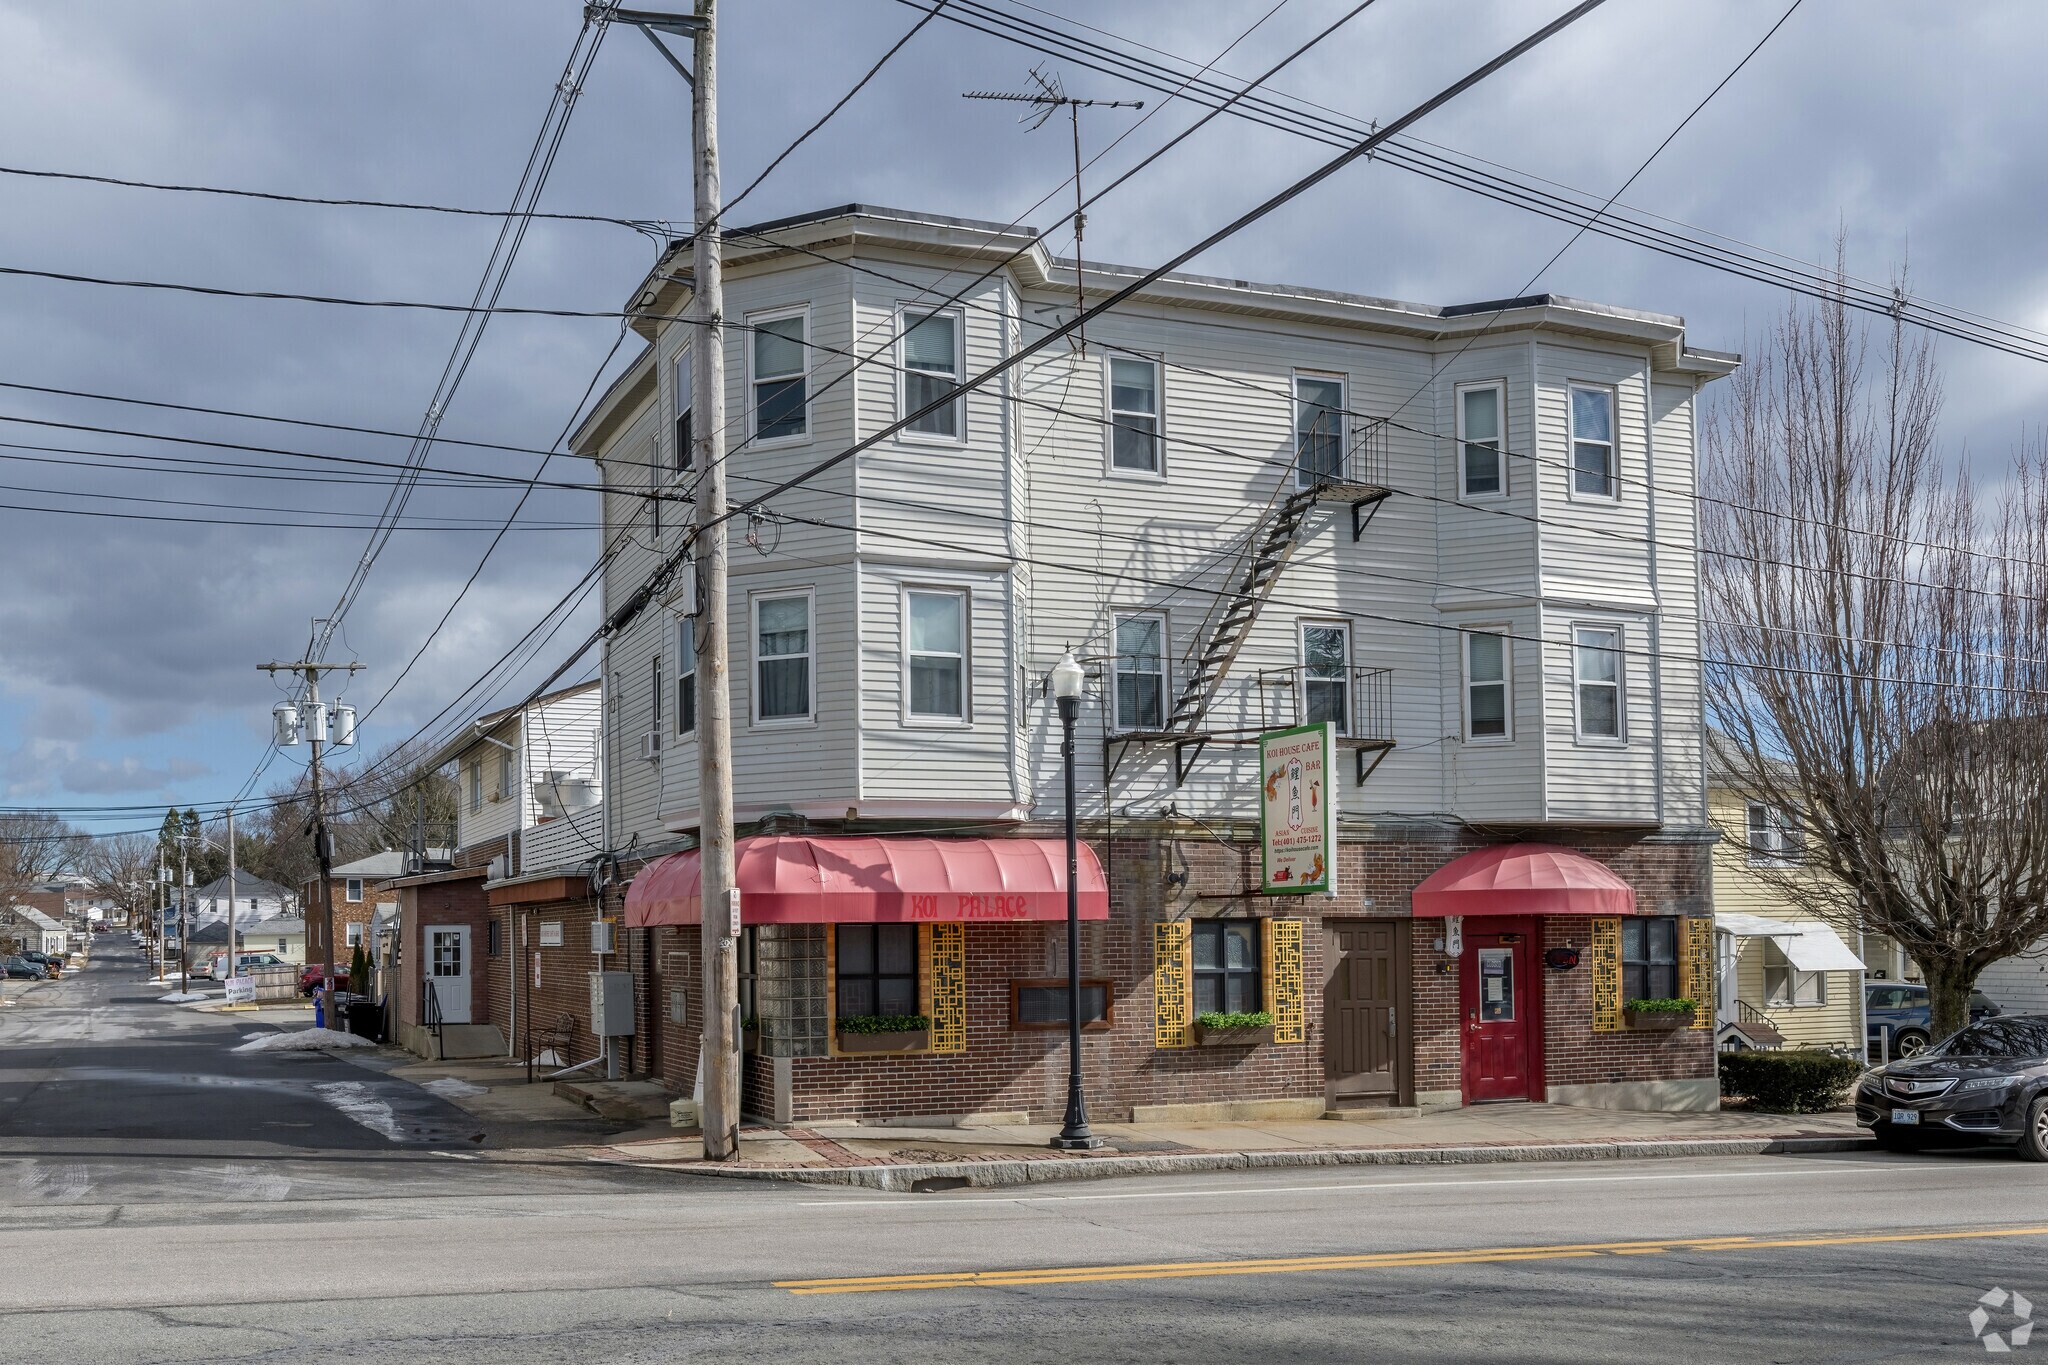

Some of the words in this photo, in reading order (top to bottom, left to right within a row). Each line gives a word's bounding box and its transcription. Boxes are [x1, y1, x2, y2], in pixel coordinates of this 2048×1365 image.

[1266, 749, 1278, 759] KOI
[1279, 745, 1300, 757] HOUSE
[1301, 741, 1320, 752] CAFE
[1305, 760, 1321, 771] BAR
[1296, 834, 1322, 844] 475-1272
[911, 895, 938, 918] KOI
[228, 987, 253, 995] Parking
[1906, 1112, 1917, 1121] 929
